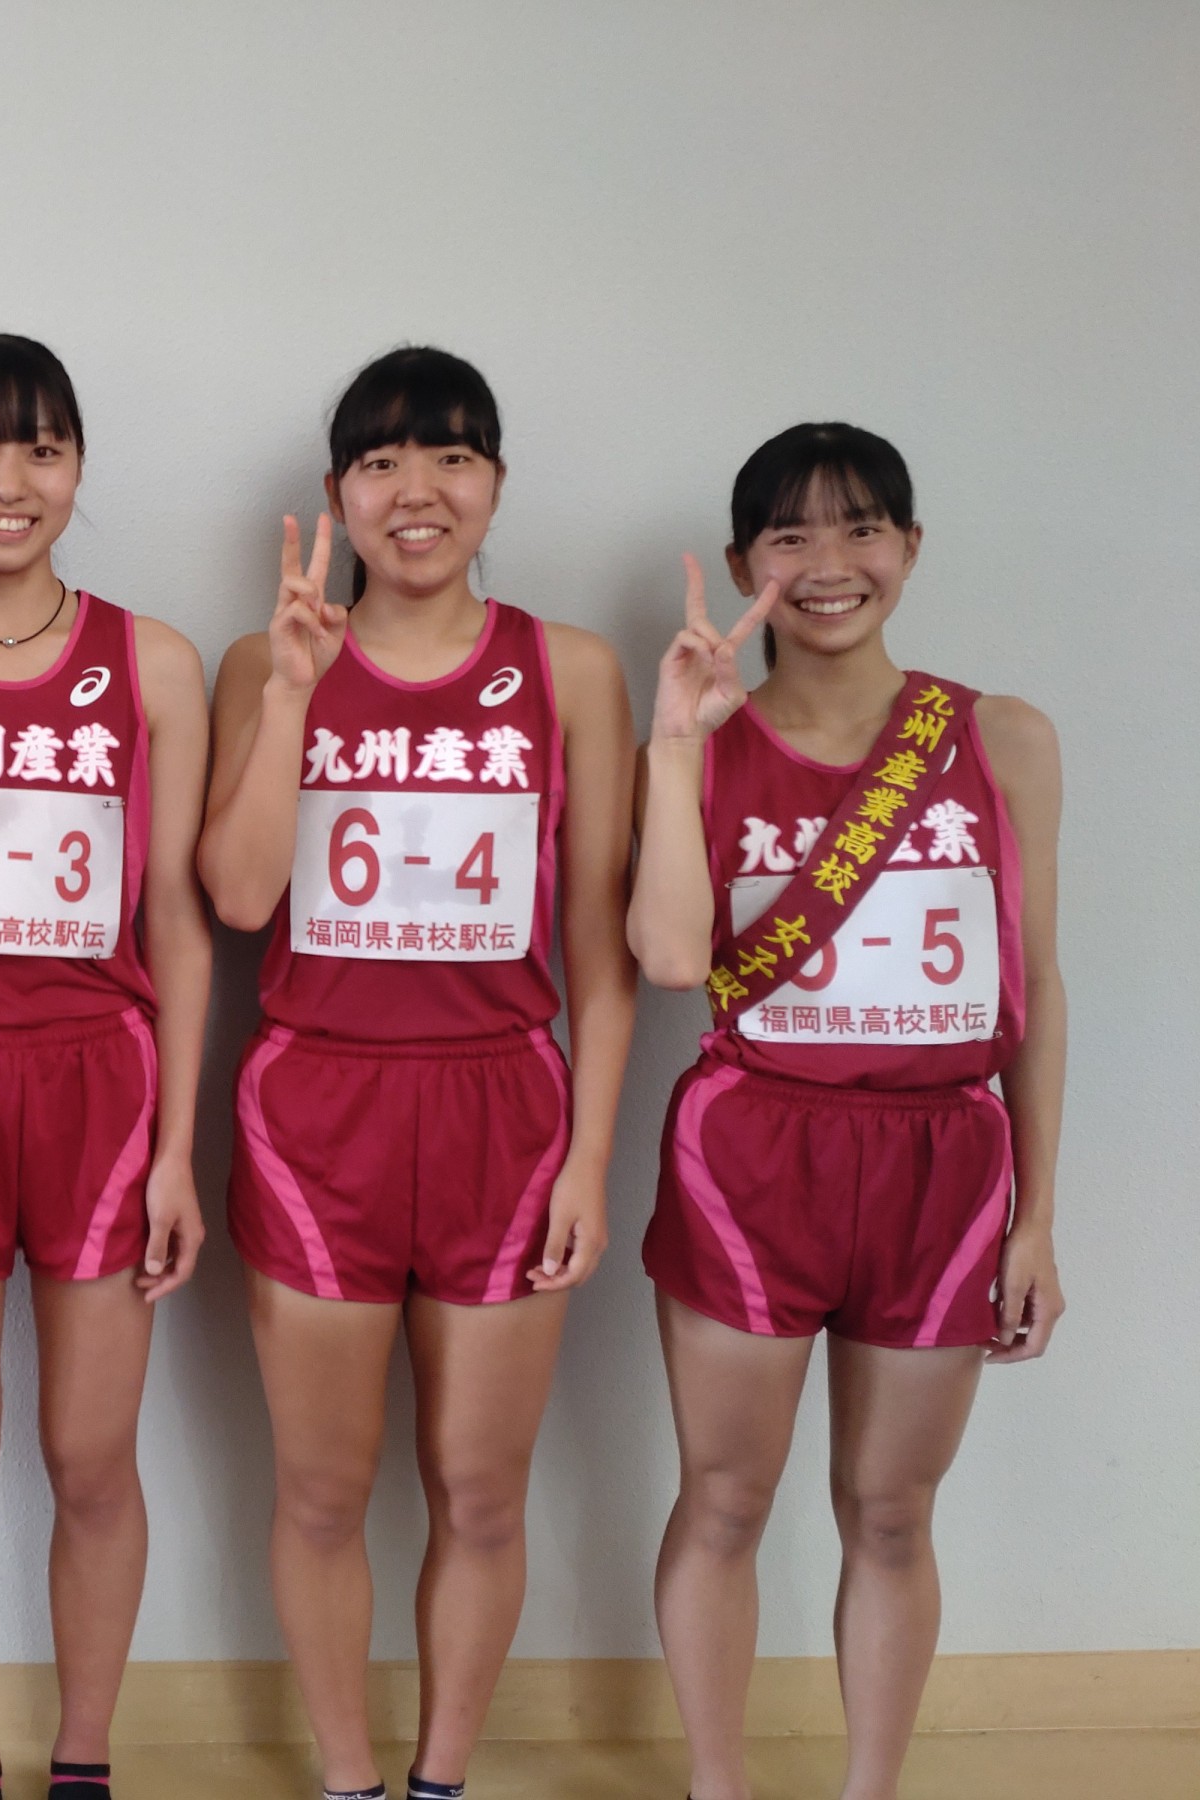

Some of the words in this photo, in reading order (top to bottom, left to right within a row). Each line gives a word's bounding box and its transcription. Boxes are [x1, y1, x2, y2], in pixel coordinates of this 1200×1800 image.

[302, 725, 533, 789] 九州産業
[812, 684, 955, 906] 九州産業高校
[328, 807, 500, 907] 6-4
[737, 798, 980, 874] 九業
[306, 916, 516, 952] 福岡県高校駅伝
[707, 914, 811, 1013] 女子駅
[757, 1002, 988, 1036] 福岡県高校駅伝
